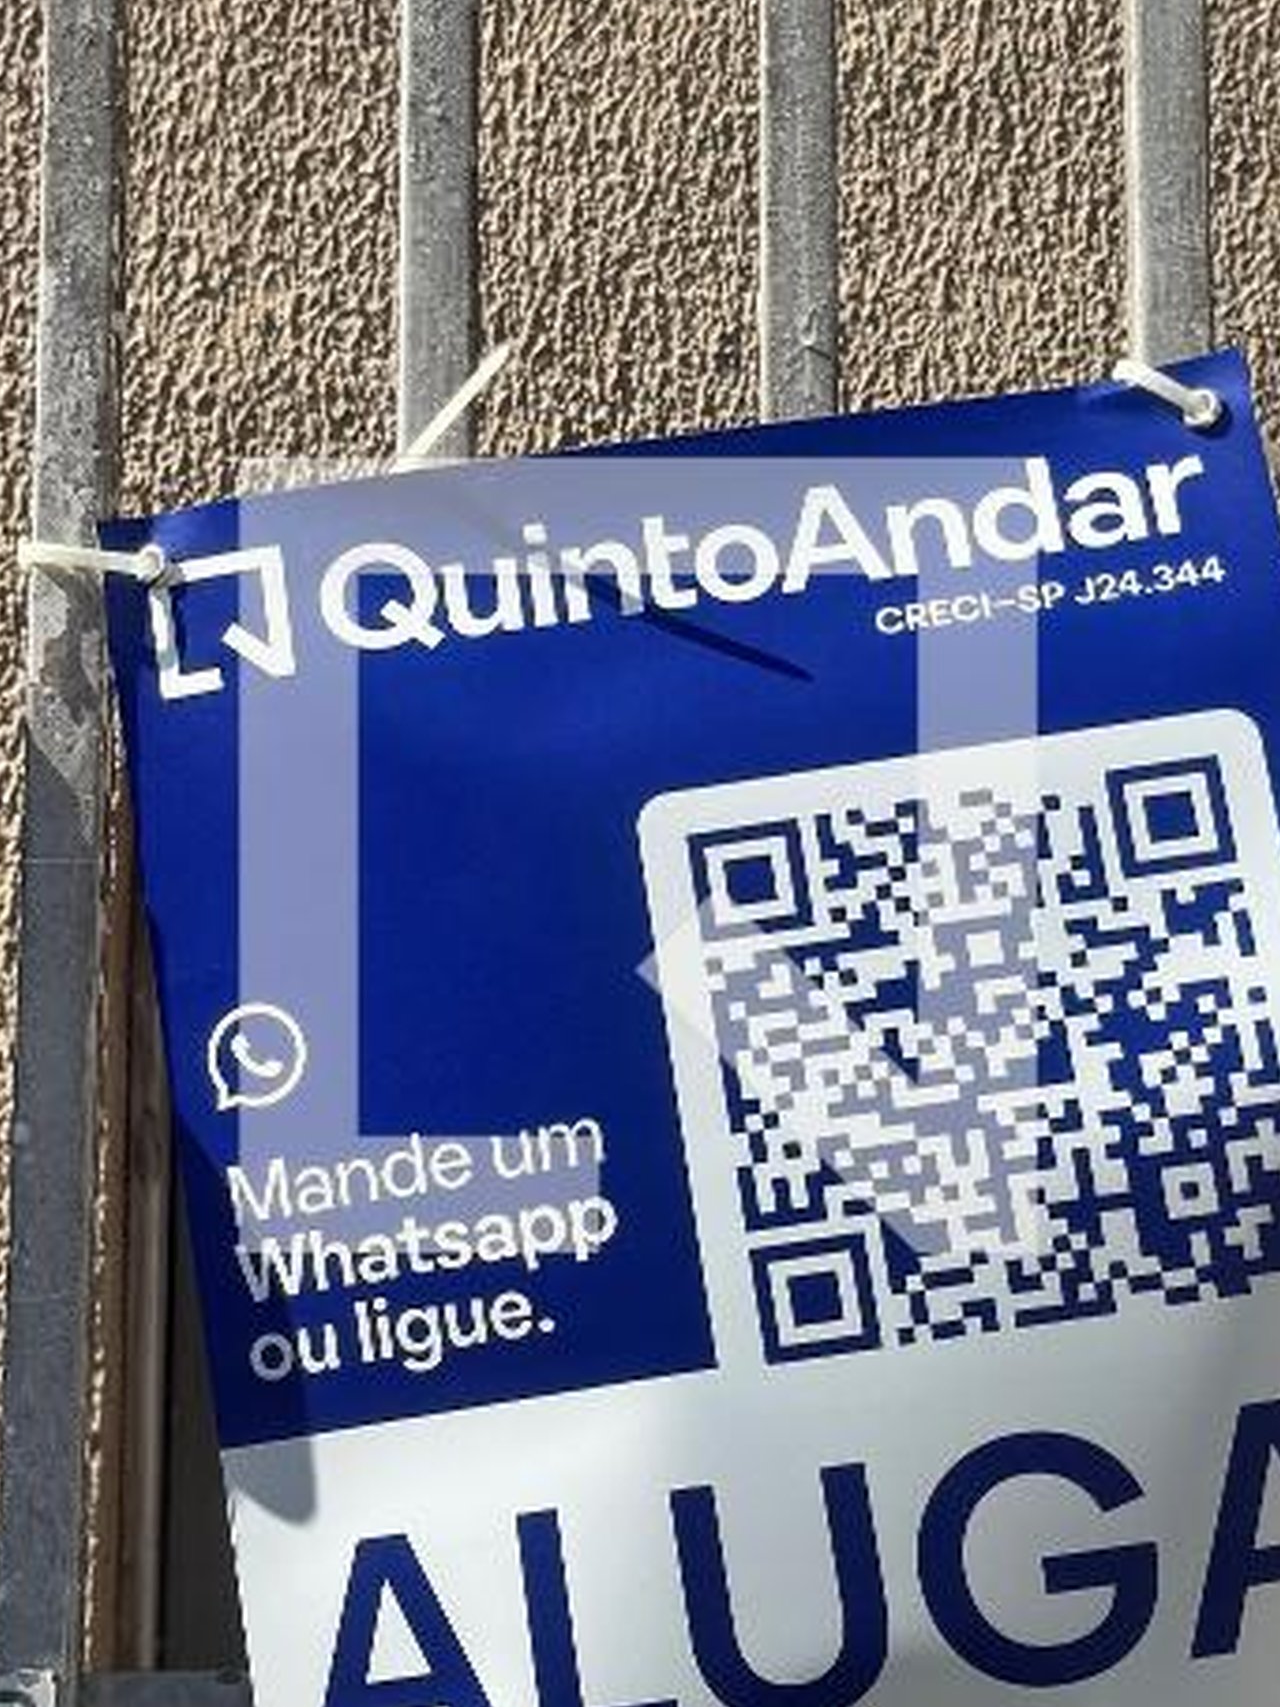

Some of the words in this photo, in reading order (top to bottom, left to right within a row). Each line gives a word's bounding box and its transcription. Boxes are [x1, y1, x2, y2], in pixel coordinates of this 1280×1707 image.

[320, 454, 1204, 651] QuintoAndar
[874, 579, 1065, 634] CRECI-SP
[1074, 555, 1226, 605] J24.344
[226, 1132, 474, 1226] Mande
[491, 1118, 606, 1178] um
[235, 1194, 618, 1302] Whatsapp
[249, 1322, 341, 1381] ou
[355, 1290, 556, 1372] ligue.
